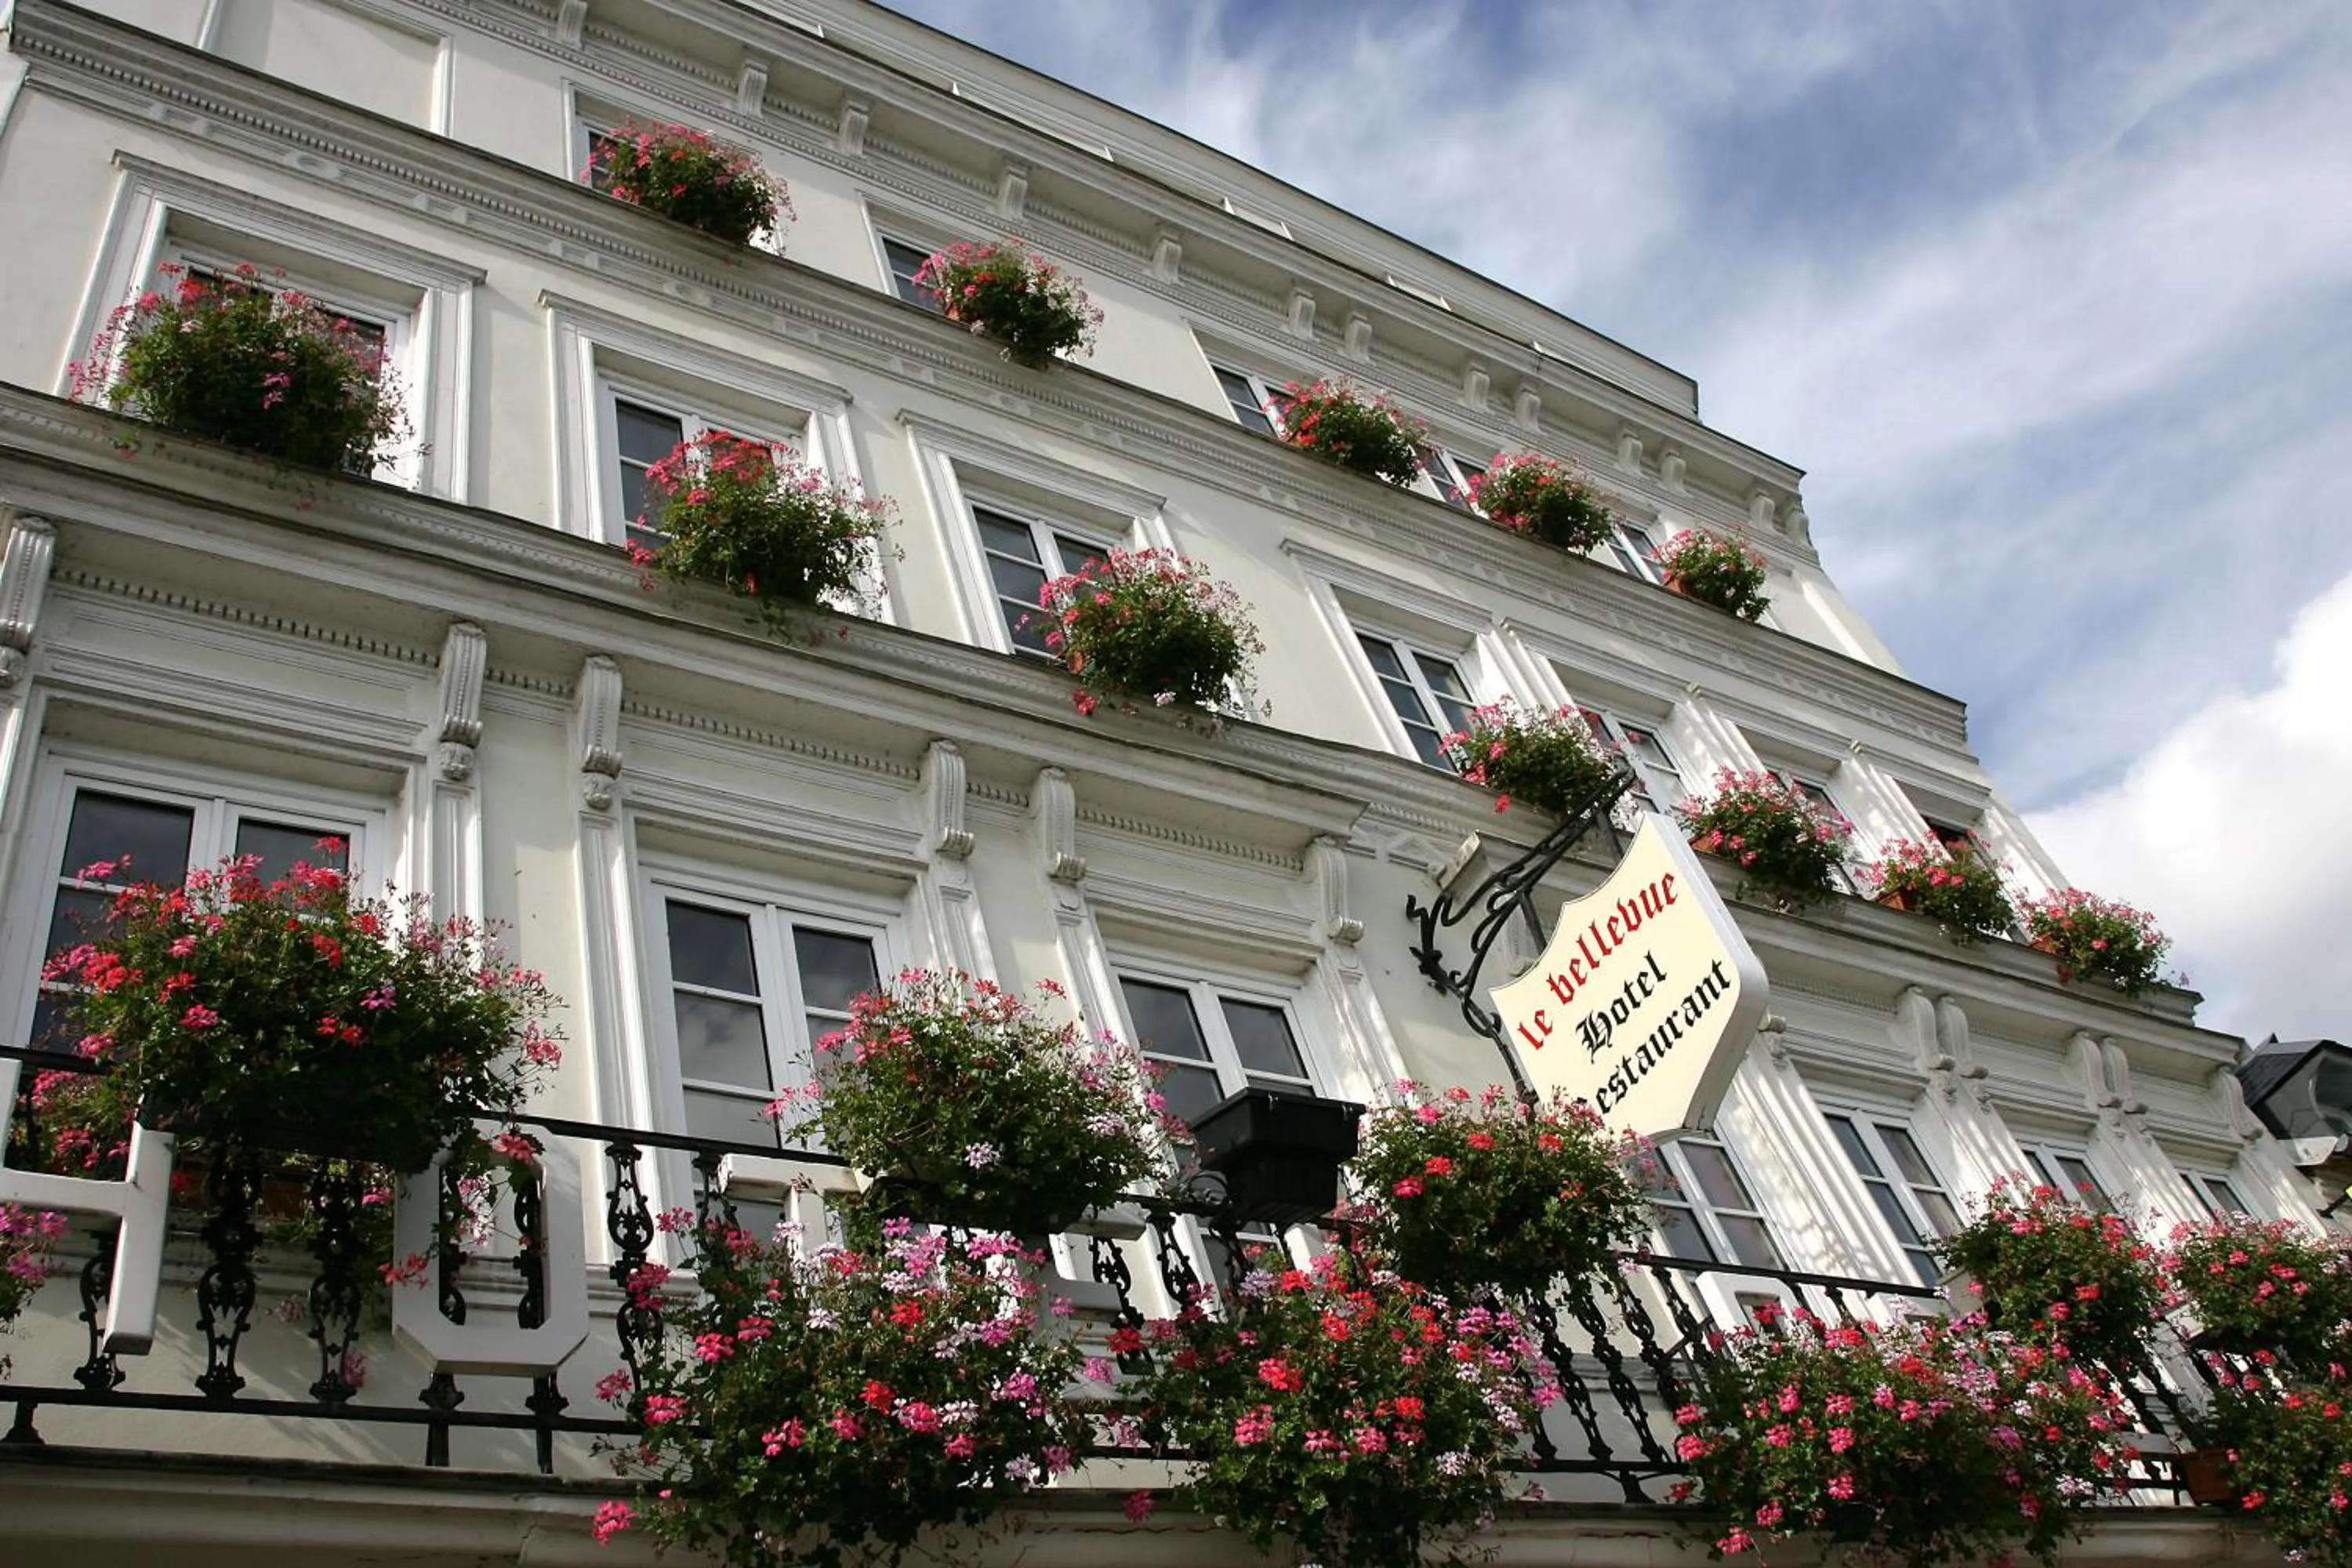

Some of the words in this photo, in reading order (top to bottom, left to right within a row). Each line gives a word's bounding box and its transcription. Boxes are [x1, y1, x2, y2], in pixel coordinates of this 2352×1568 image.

[1517, 1009, 1553, 1051] le
[1545, 872, 1679, 1006] bellevue
[1575, 950, 1668, 1065] Hotel
[1577, 958, 1732, 1115] estaurant
